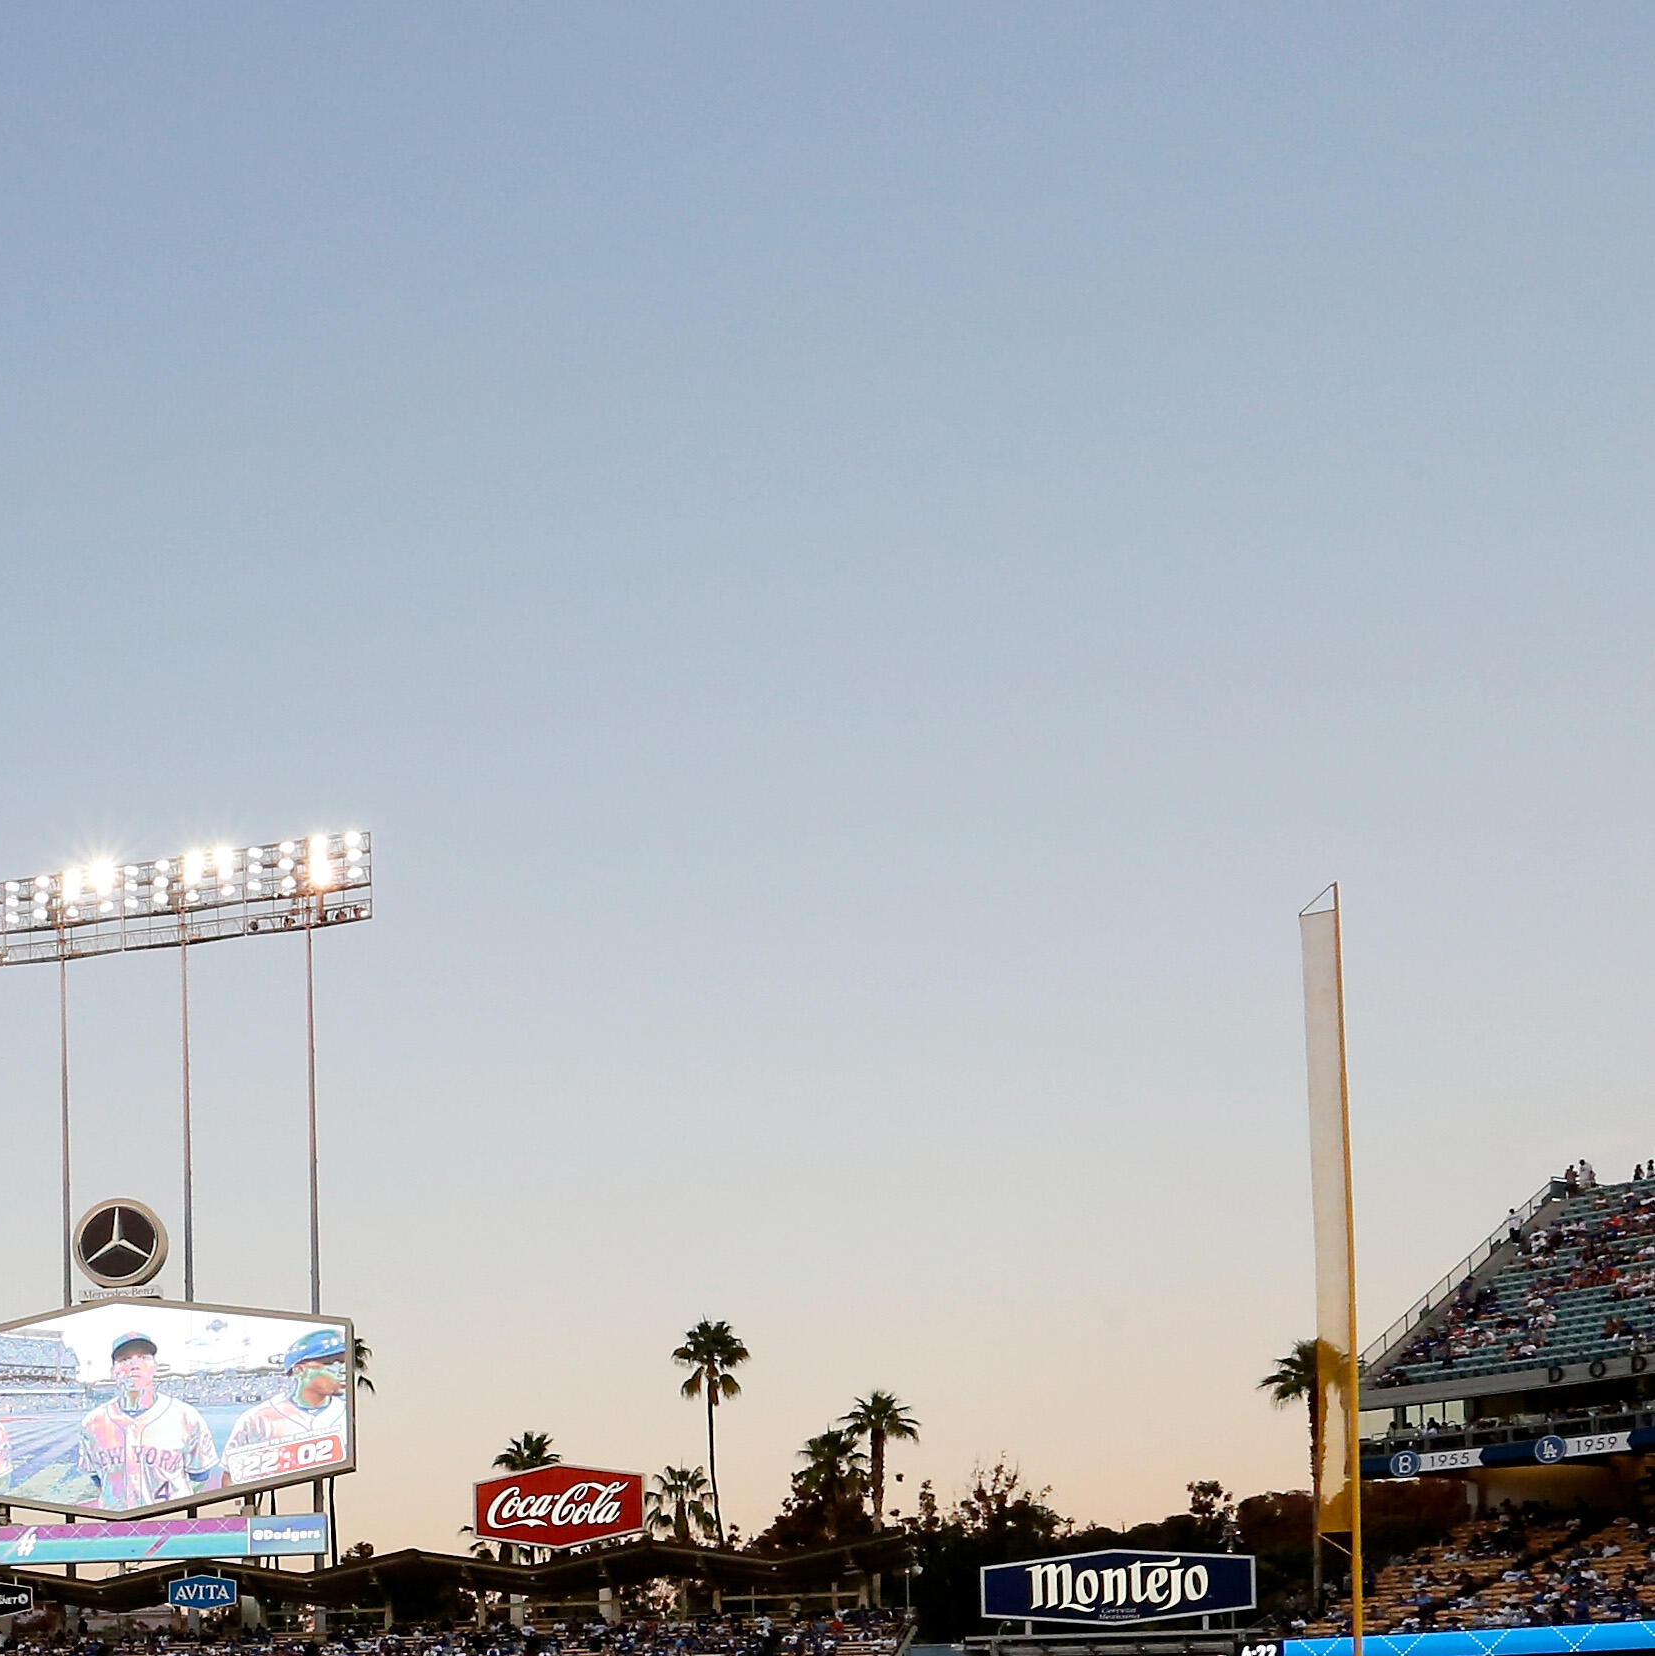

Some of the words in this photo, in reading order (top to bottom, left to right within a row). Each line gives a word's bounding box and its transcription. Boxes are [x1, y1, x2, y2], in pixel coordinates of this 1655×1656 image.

[1576, 1436, 1618, 1453] 1959
[244, 1439, 334, 1476] 22:02
[1398, 1457, 1412, 1474] B
[1430, 1453, 1470, 1468] 1955
[154, 1480, 170, 1502] 4
[486, 1481, 630, 1530] Coca-Cola
[252, 1527, 321, 1543] @Dodgers
[174, 1583, 231, 1600] AVITA
[1024, 1556, 1209, 1613] Montejo
